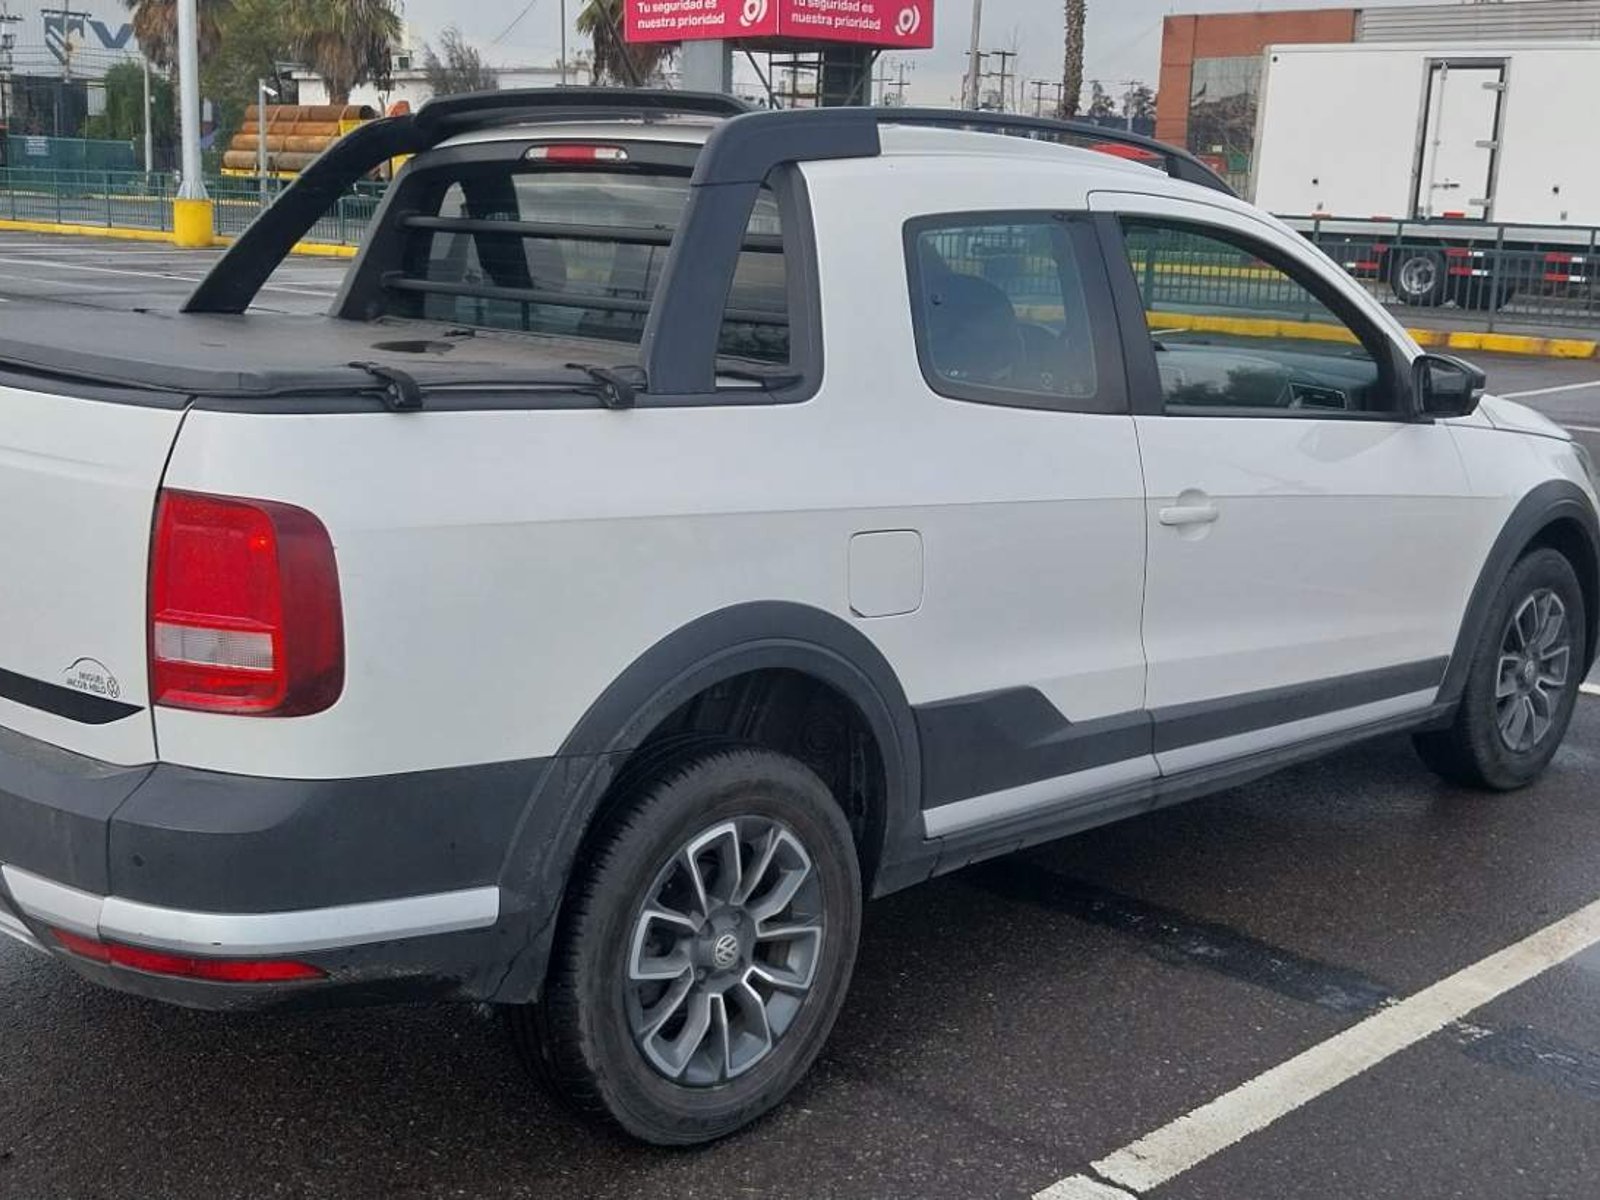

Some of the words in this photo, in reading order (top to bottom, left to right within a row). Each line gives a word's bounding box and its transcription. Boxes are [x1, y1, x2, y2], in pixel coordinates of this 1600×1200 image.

[637, 2, 651, 13] Tu
[652, 0, 702, 14] seguridad
[704, 0, 717, 9] es
[807, 0, 860, 11] seguridad
[862, 5, 875, 13] es
[638, 17, 676, 29] nuestra
[677, 12, 725, 28] prioridad
[791, 13, 833, 25] nuestra
[834, 17, 881, 30] prioridad
